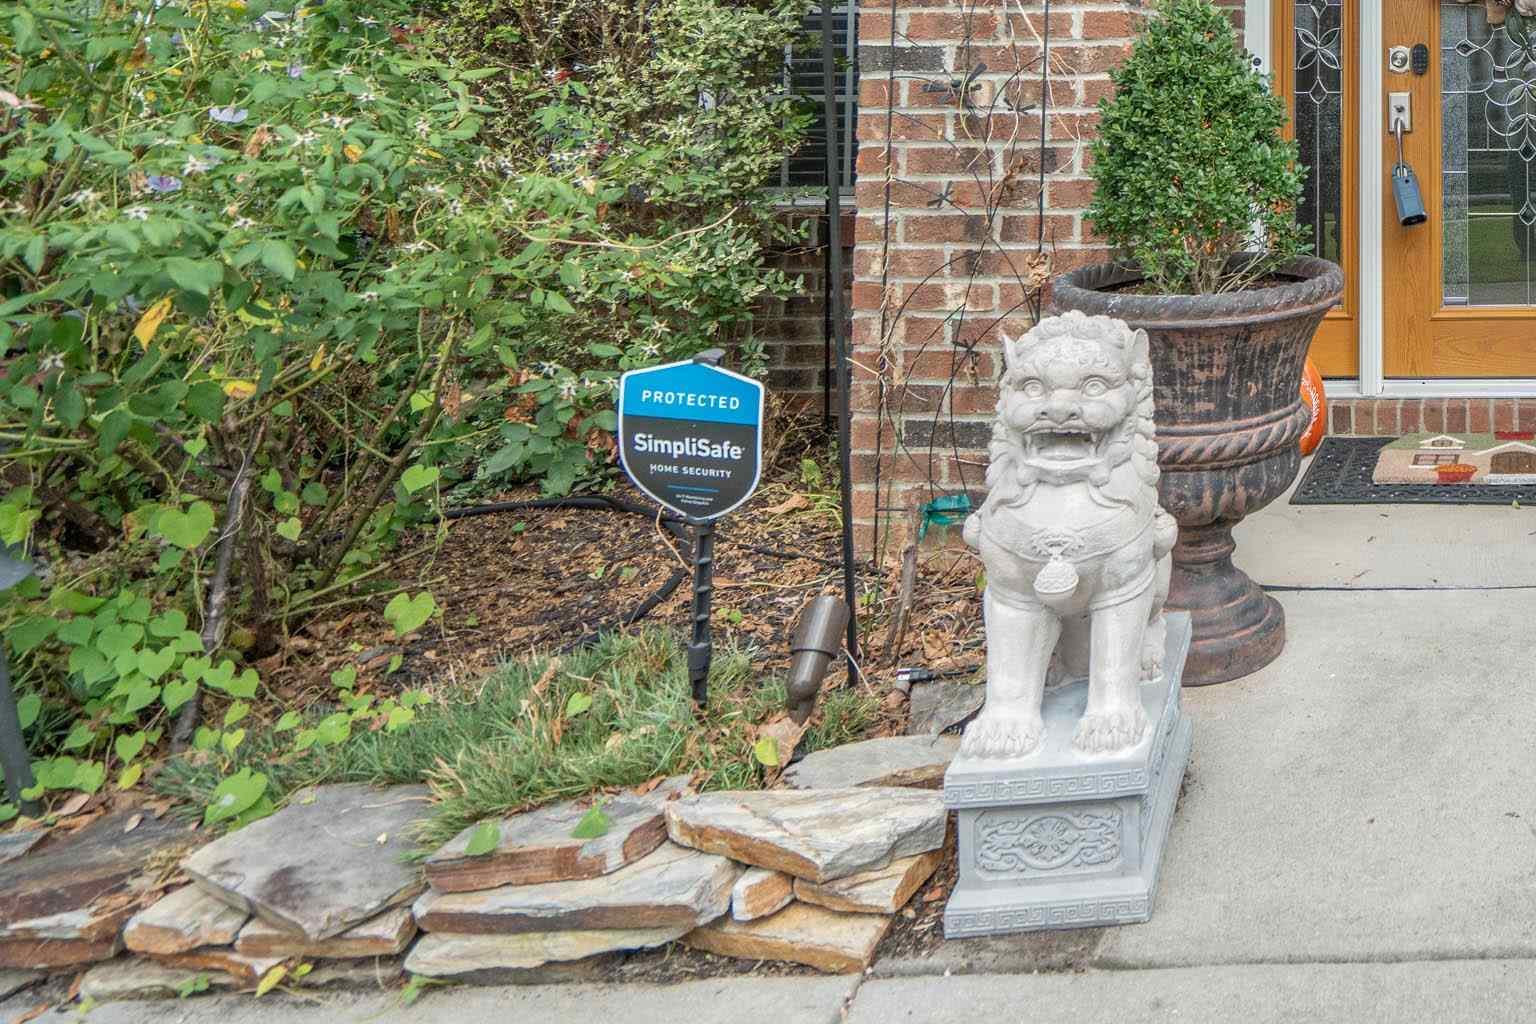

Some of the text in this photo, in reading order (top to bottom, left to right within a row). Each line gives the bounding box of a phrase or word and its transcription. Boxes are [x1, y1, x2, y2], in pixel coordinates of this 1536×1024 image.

[641, 389, 740, 410] PROTECTED
[633, 432, 743, 460] SimpliSafe
[650, 463, 732, 478] HOME SECURITY
